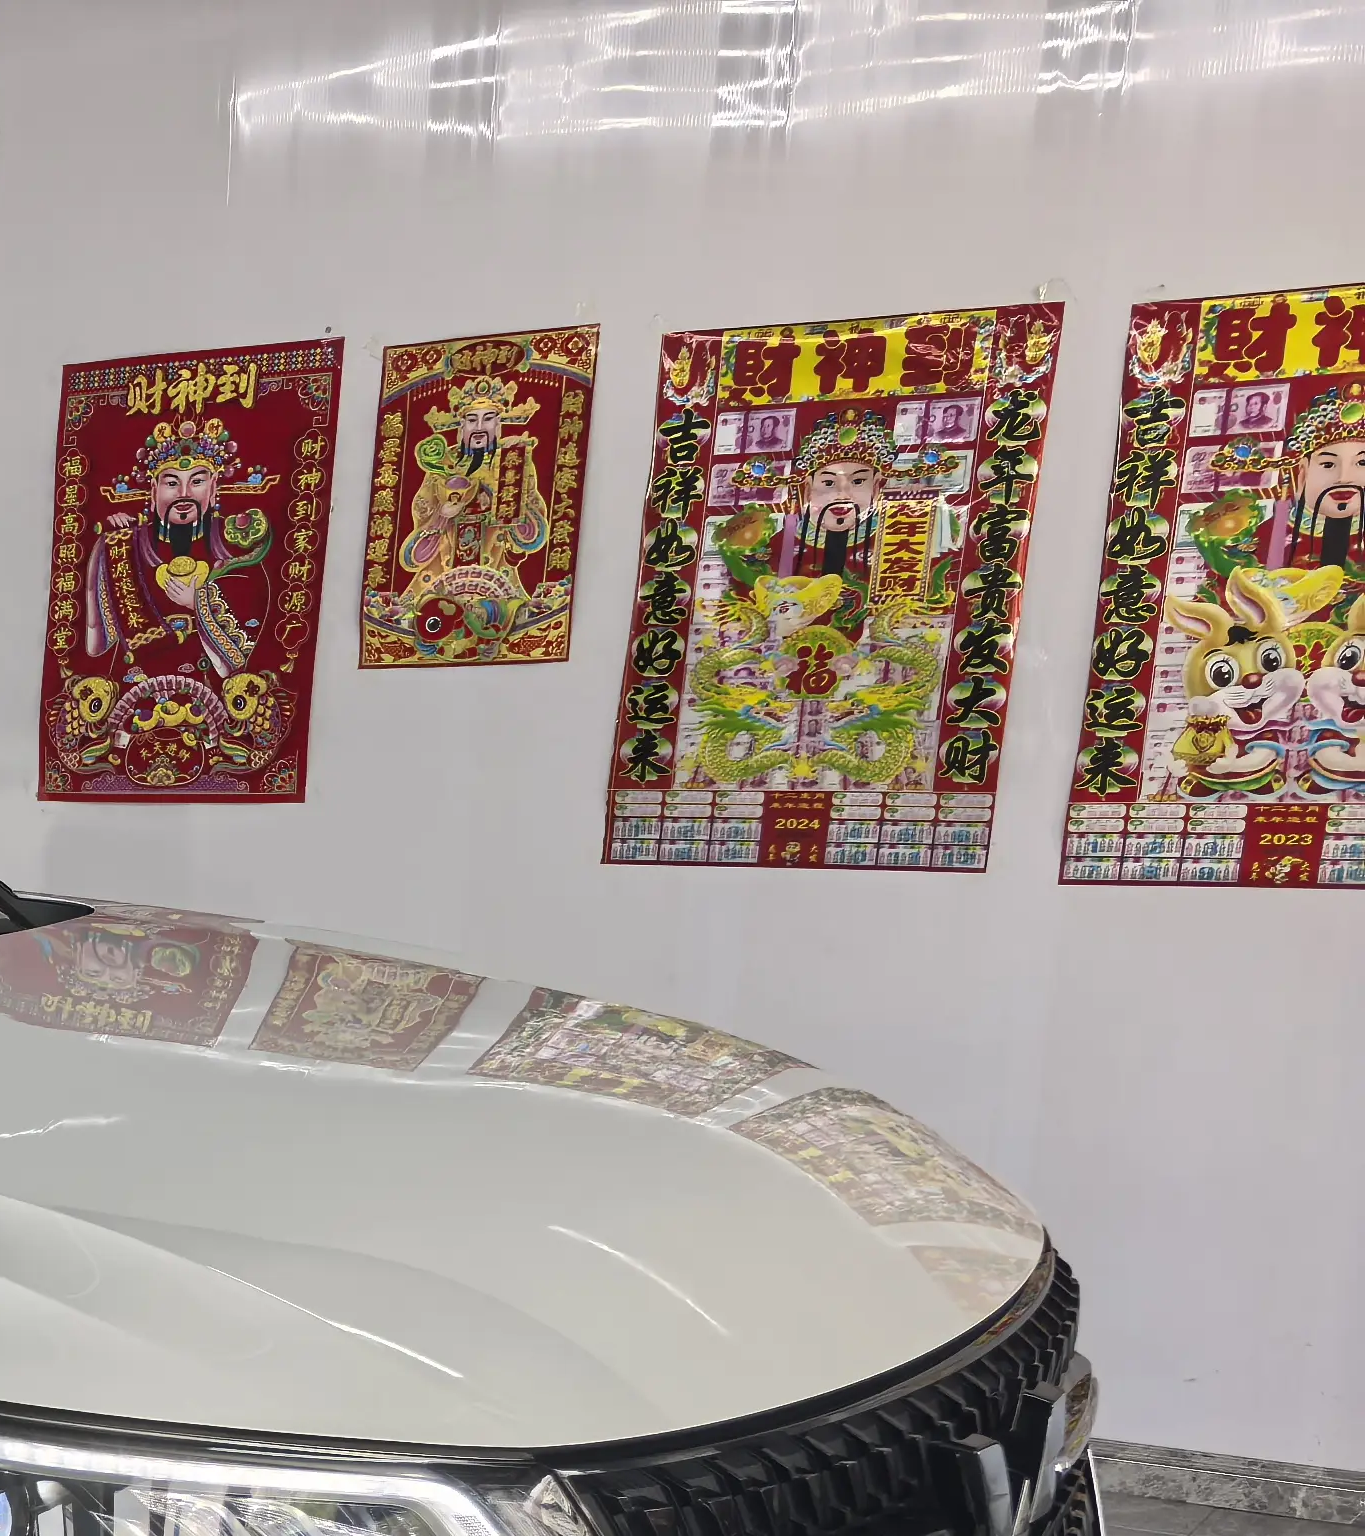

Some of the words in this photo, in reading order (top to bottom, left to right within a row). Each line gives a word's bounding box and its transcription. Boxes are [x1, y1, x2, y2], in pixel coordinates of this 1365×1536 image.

[126, 362, 258, 416] 财神到
[720, 323, 973, 405] 財神到
[48, 455, 83, 650] 福星高照福满堂
[283, 439, 325, 643] 财神到家财源广
[626, 408, 711, 783] 吉祥如意好运来
[944, 390, 1042, 785] 龙年富贵发大财
[1076, 386, 1186, 796] 吉祥如意好运来
[785, 642, 838, 695] 福
[774, 818, 820, 830] 2024
[1258, 833, 1313, 845] 2023
